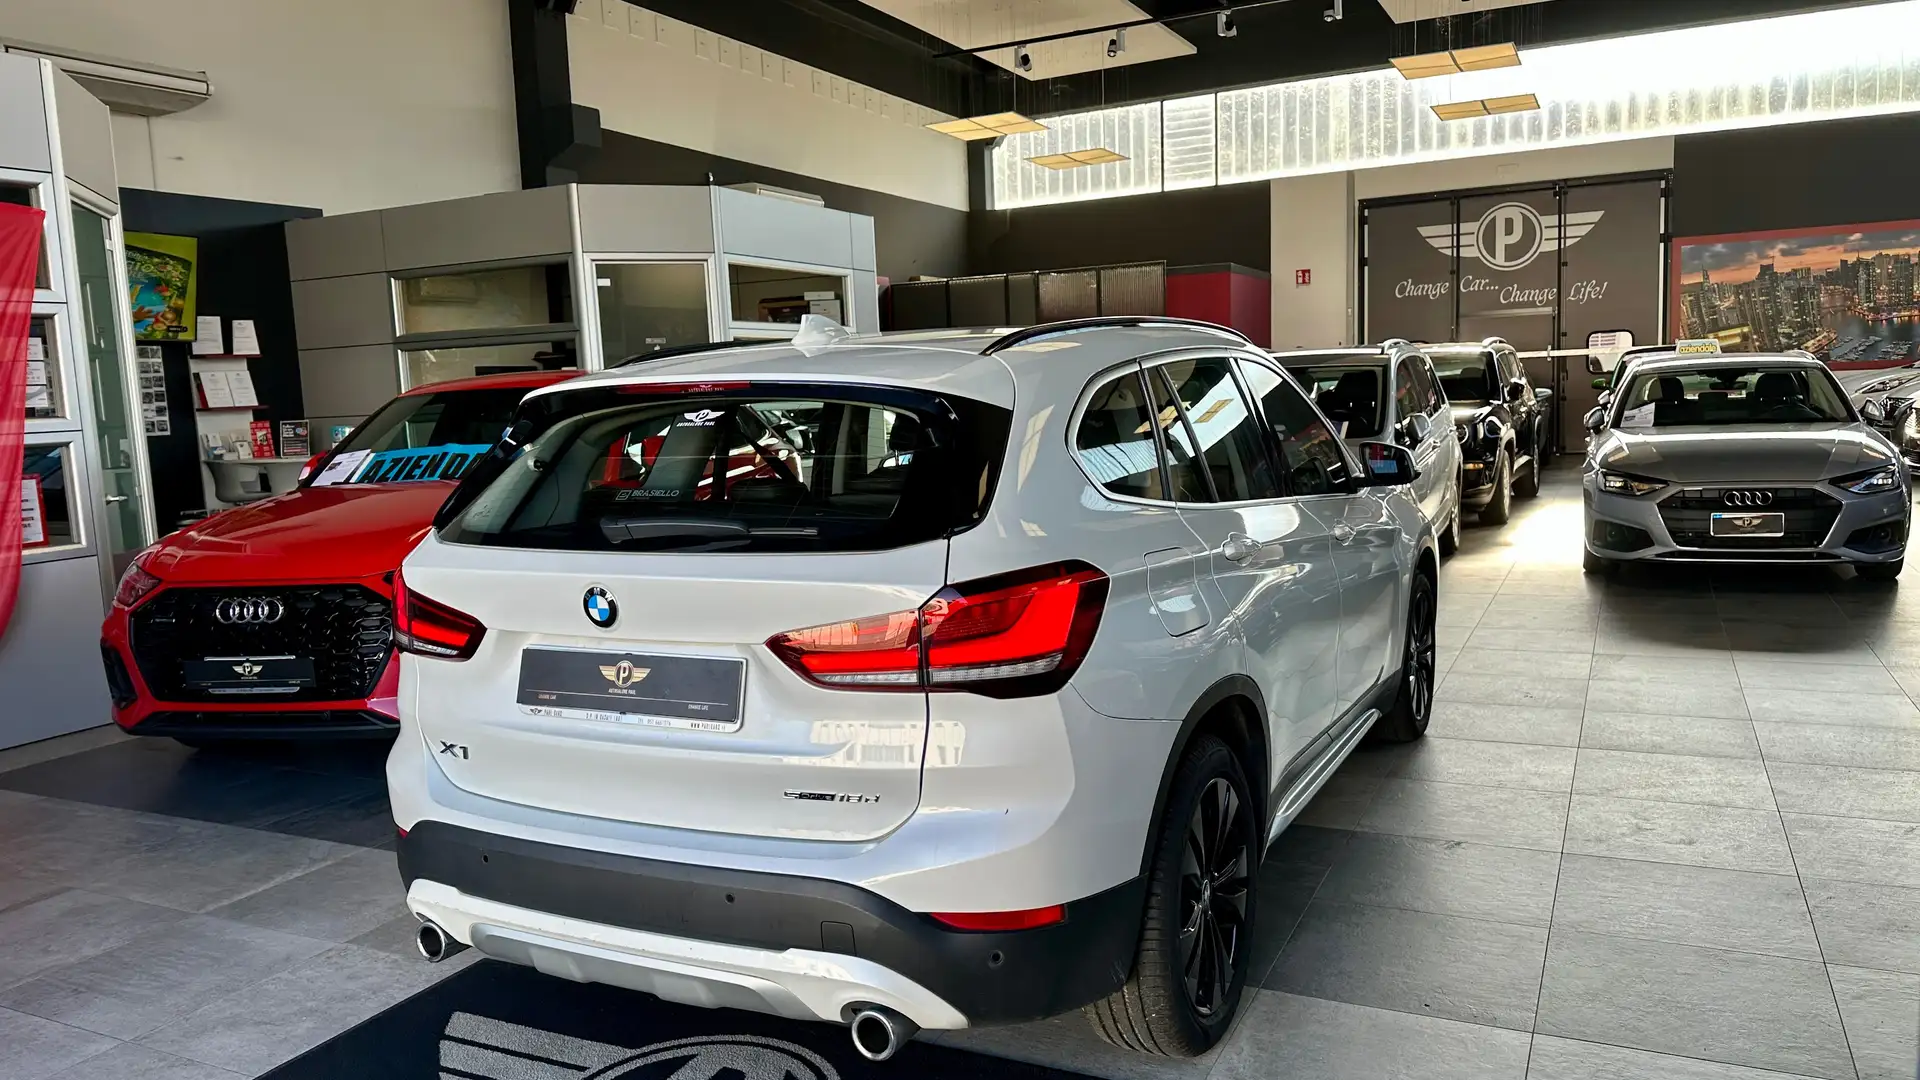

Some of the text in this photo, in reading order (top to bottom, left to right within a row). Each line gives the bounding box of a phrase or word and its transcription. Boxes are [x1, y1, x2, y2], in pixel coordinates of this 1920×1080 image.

[1395, 275, 1609, 306] Change Car... Change Life!
[631, 489, 680, 497] BRASIELLO
[440, 740, 469, 760] X1
